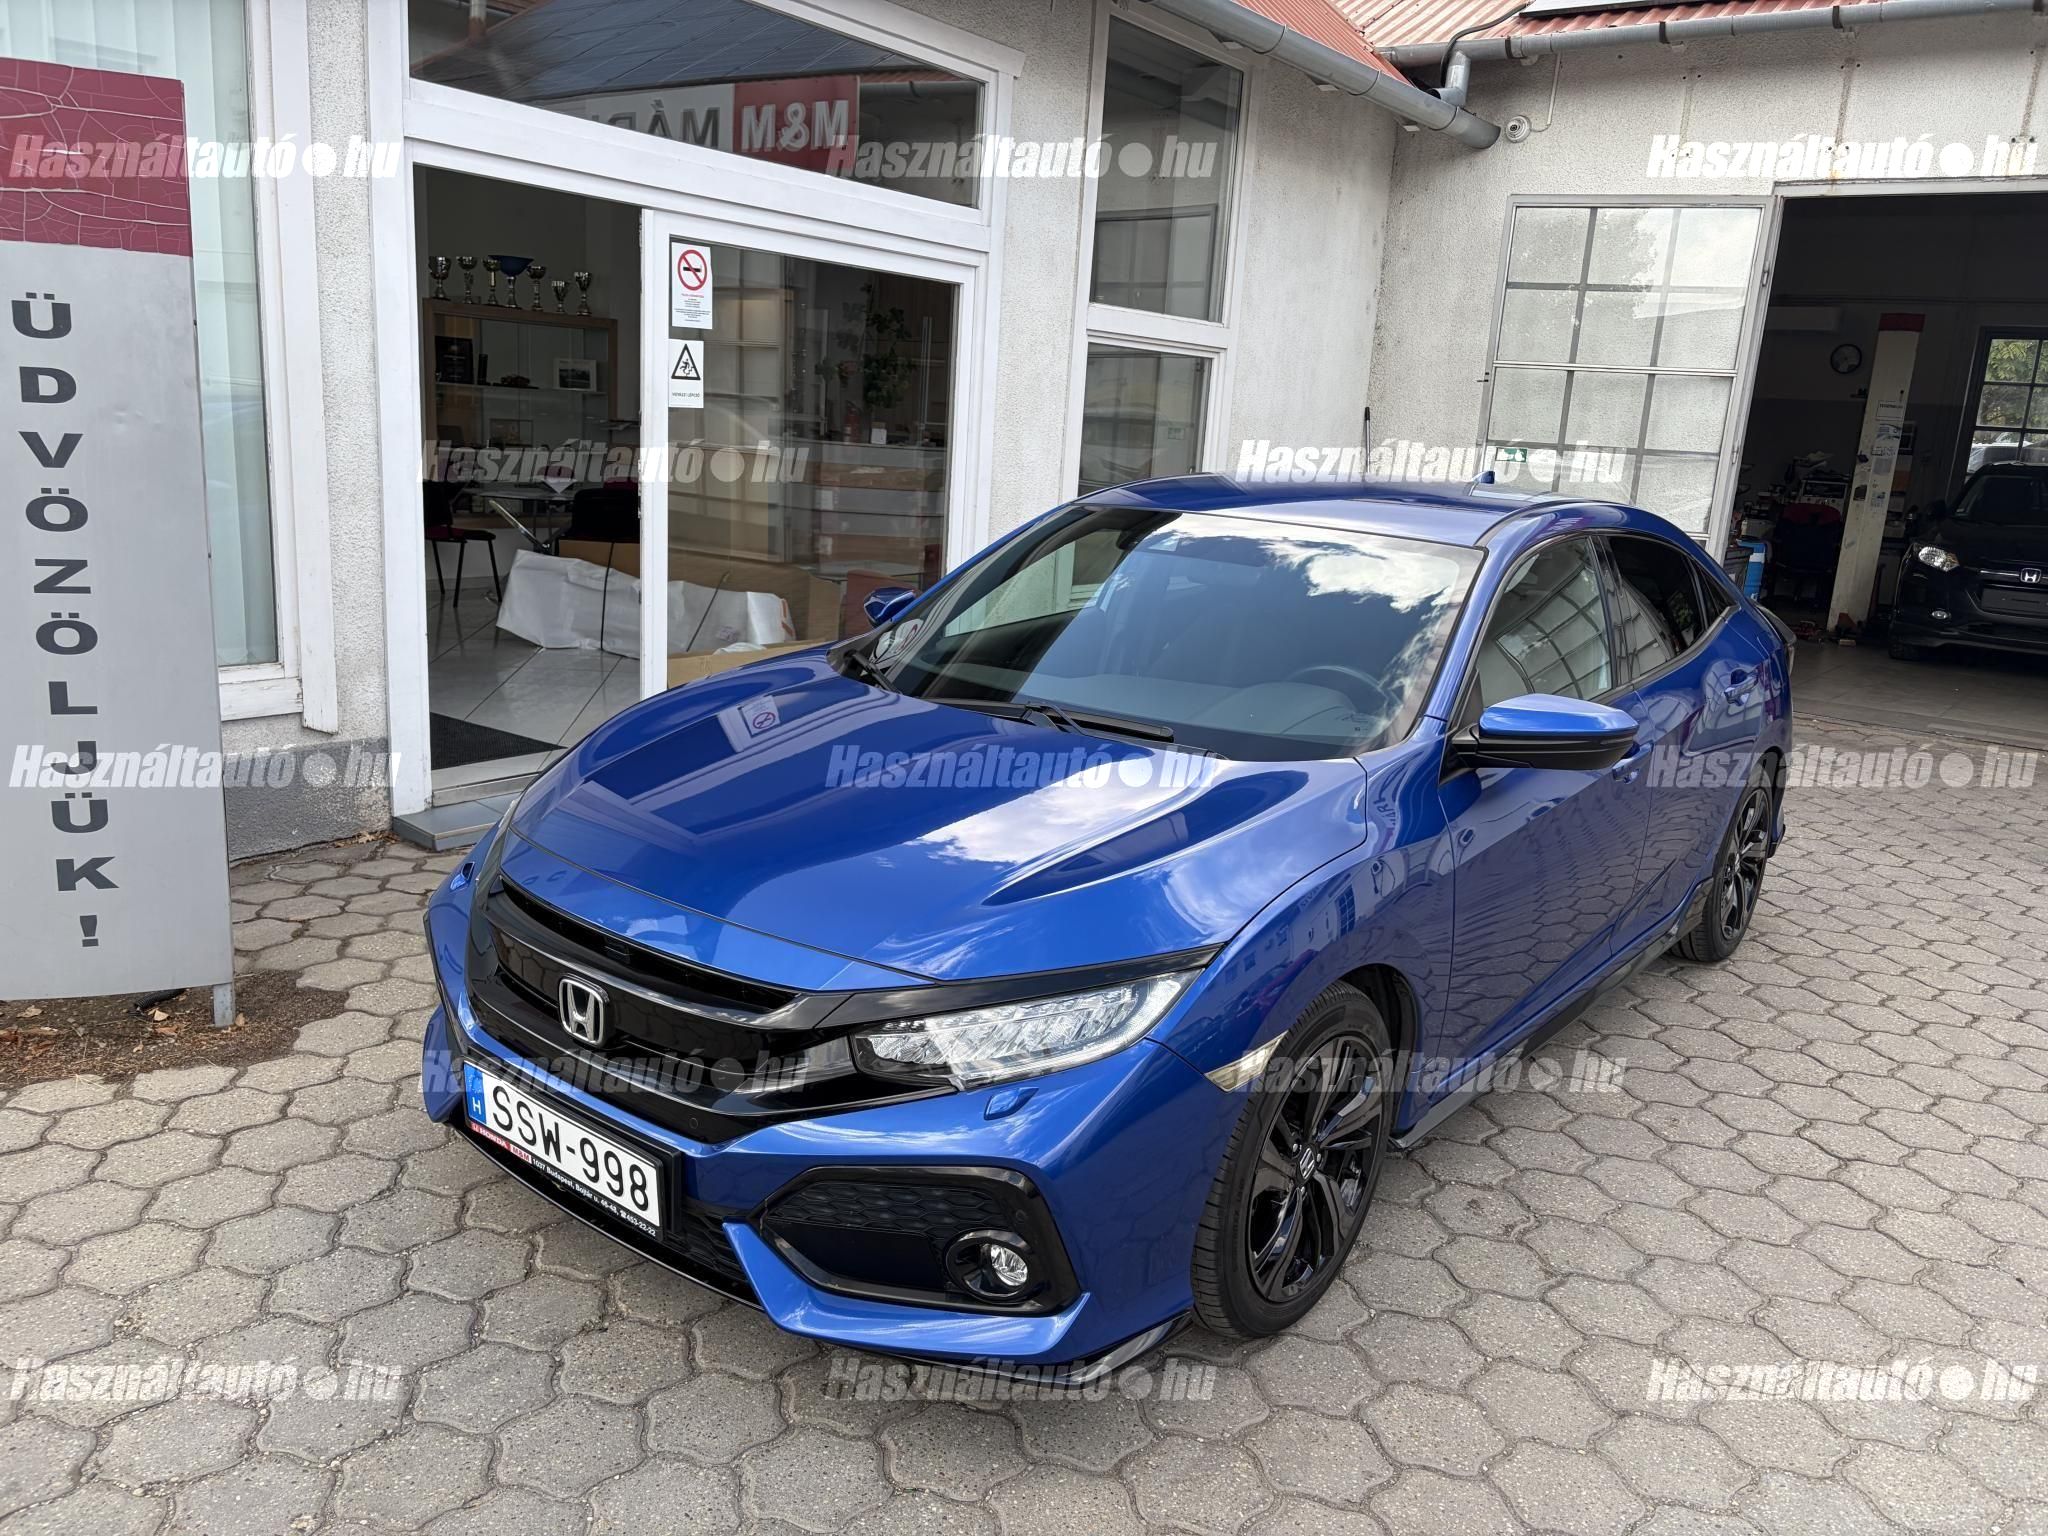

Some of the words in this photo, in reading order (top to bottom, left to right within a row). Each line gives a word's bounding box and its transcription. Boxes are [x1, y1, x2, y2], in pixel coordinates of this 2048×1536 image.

[479, 1127, 508, 1149] HONDA
[492, 1085, 649, 1212] SSW-998
[532, 1158, 546, 1171] 1037
